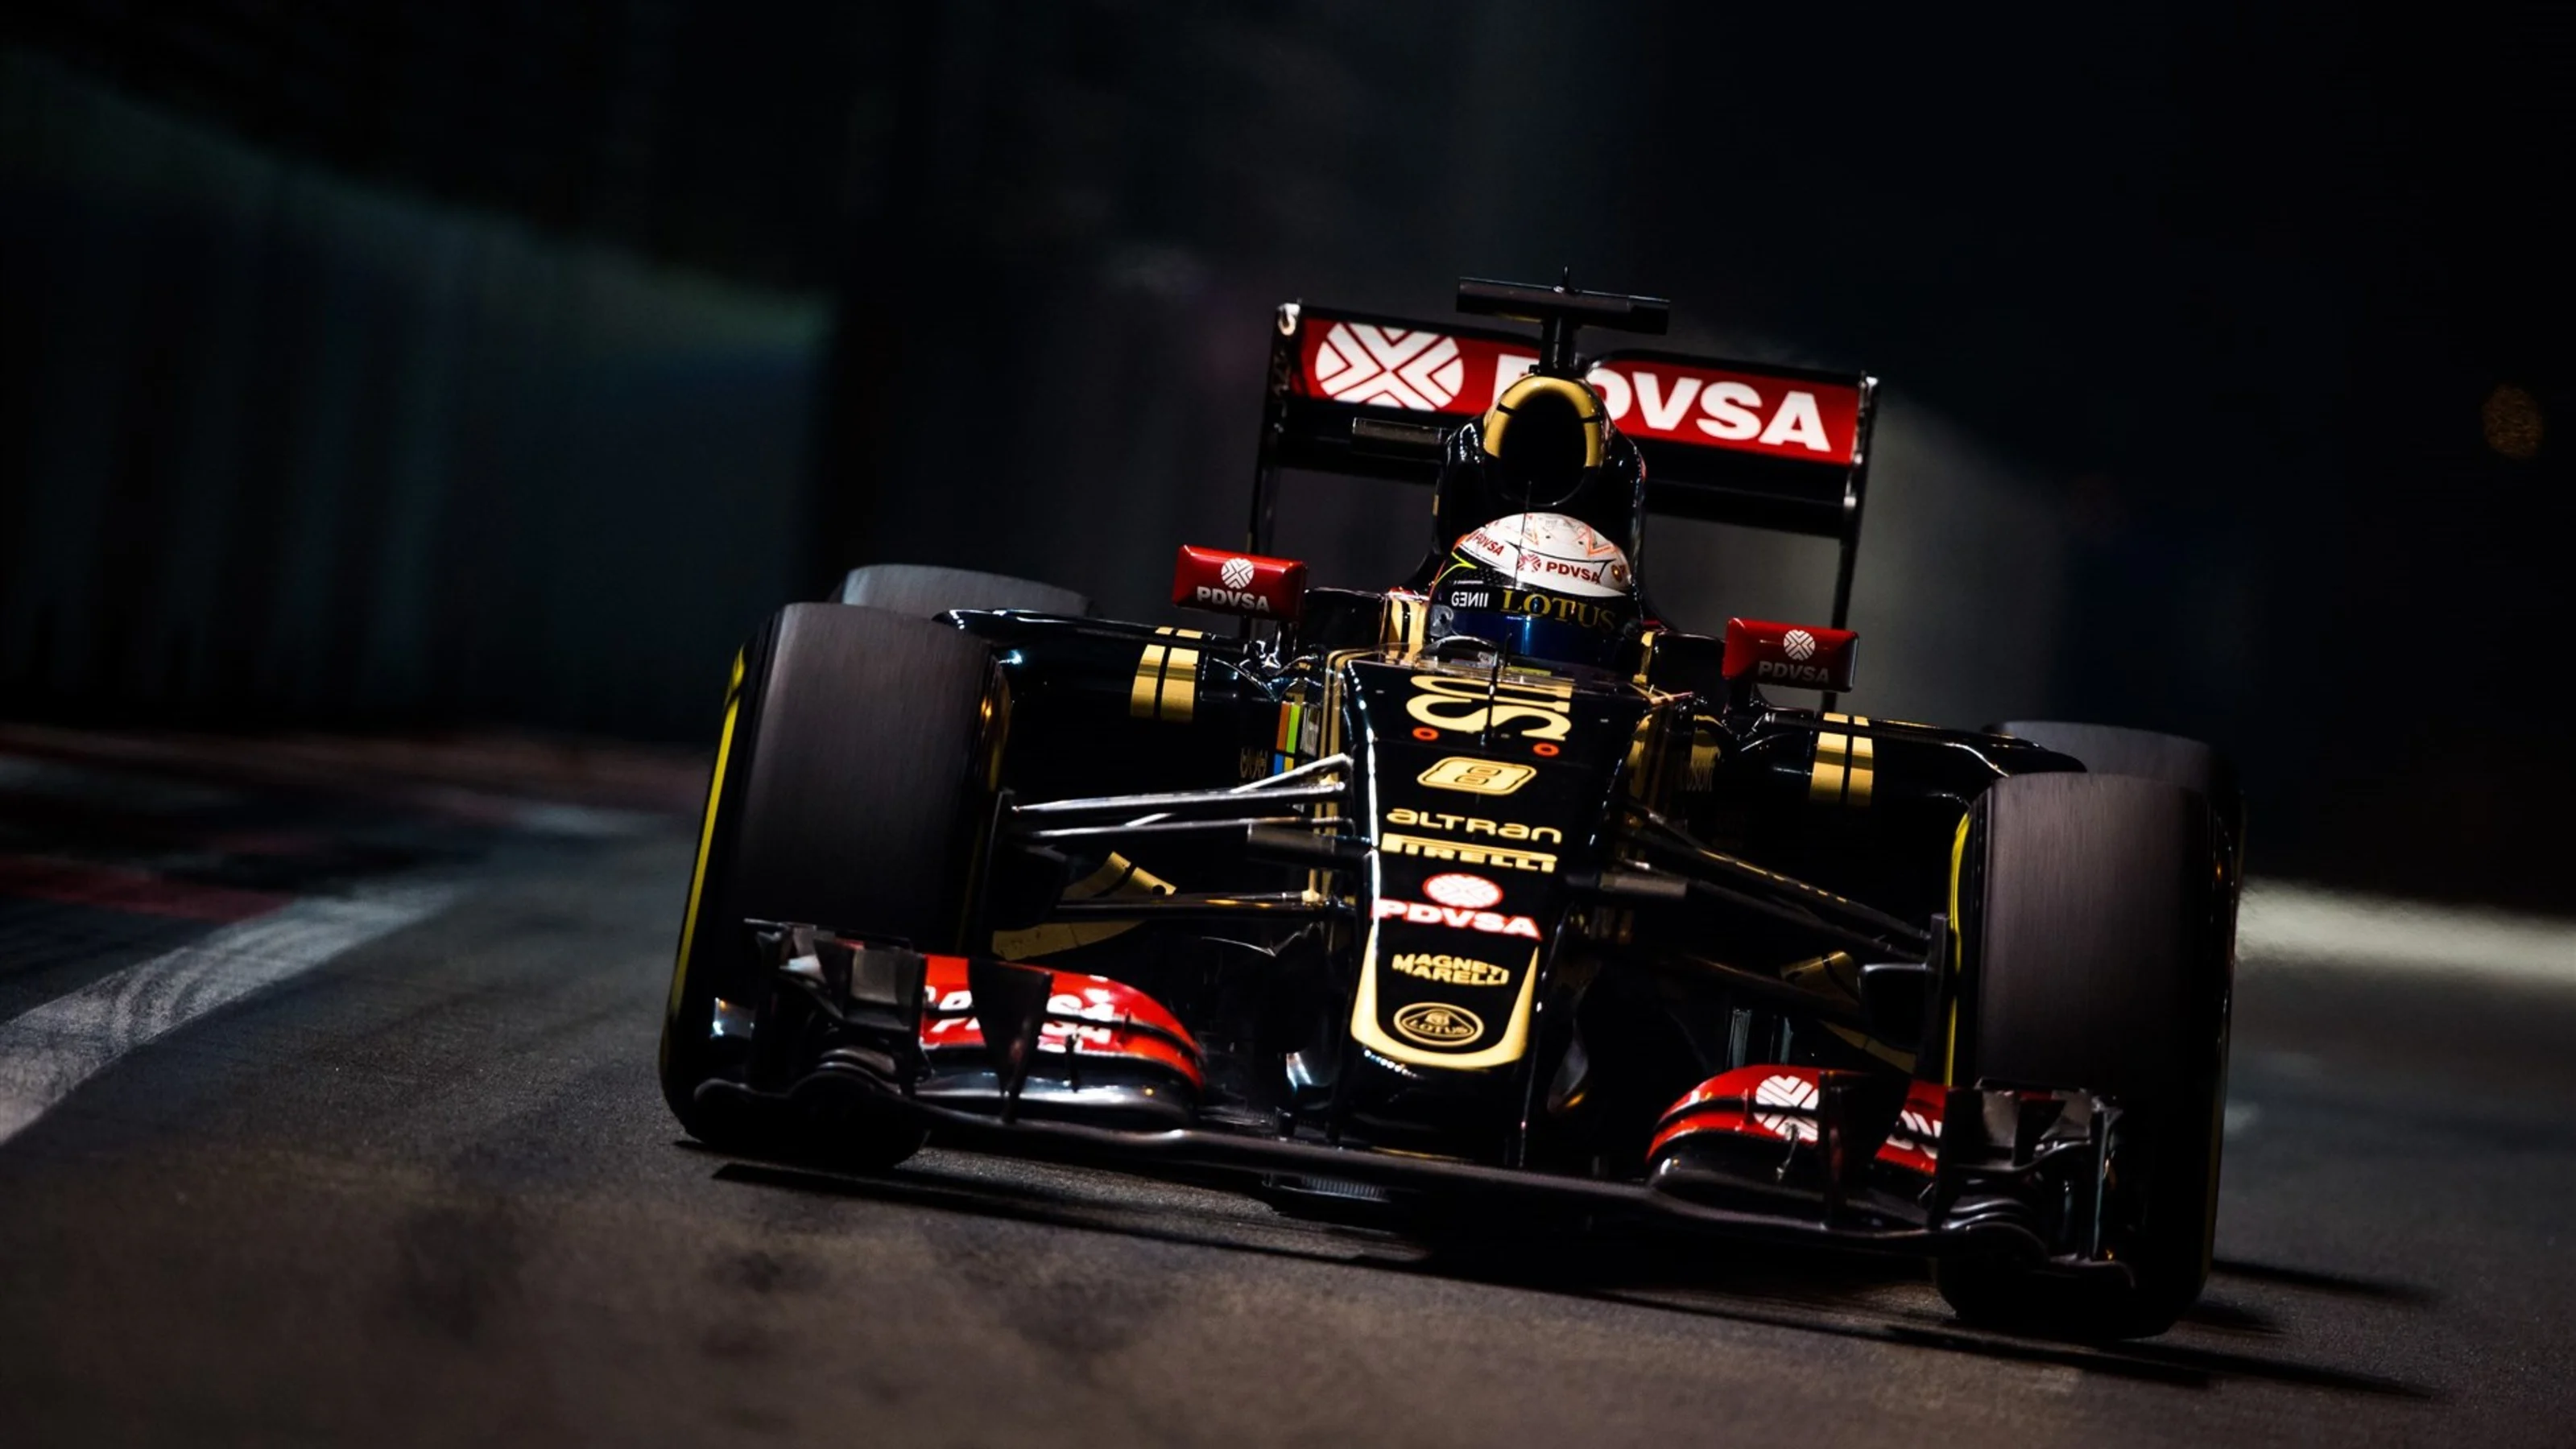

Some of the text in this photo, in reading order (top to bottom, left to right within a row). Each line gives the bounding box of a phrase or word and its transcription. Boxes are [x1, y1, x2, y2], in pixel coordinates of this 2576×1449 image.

[1545, 561, 1601, 584] PDVSA
[1196, 585, 1271, 613] PDVSA
[1499, 588, 1616, 634] LOTUS
[1757, 660, 1830, 684] PDVSA
[1380, 832, 1558, 874] PIRELLI
[1370, 896, 1544, 943] PDVSA
[1391, 952, 1511, 985] MAGNETI
[1408, 1018, 1470, 1035] LOTUS
